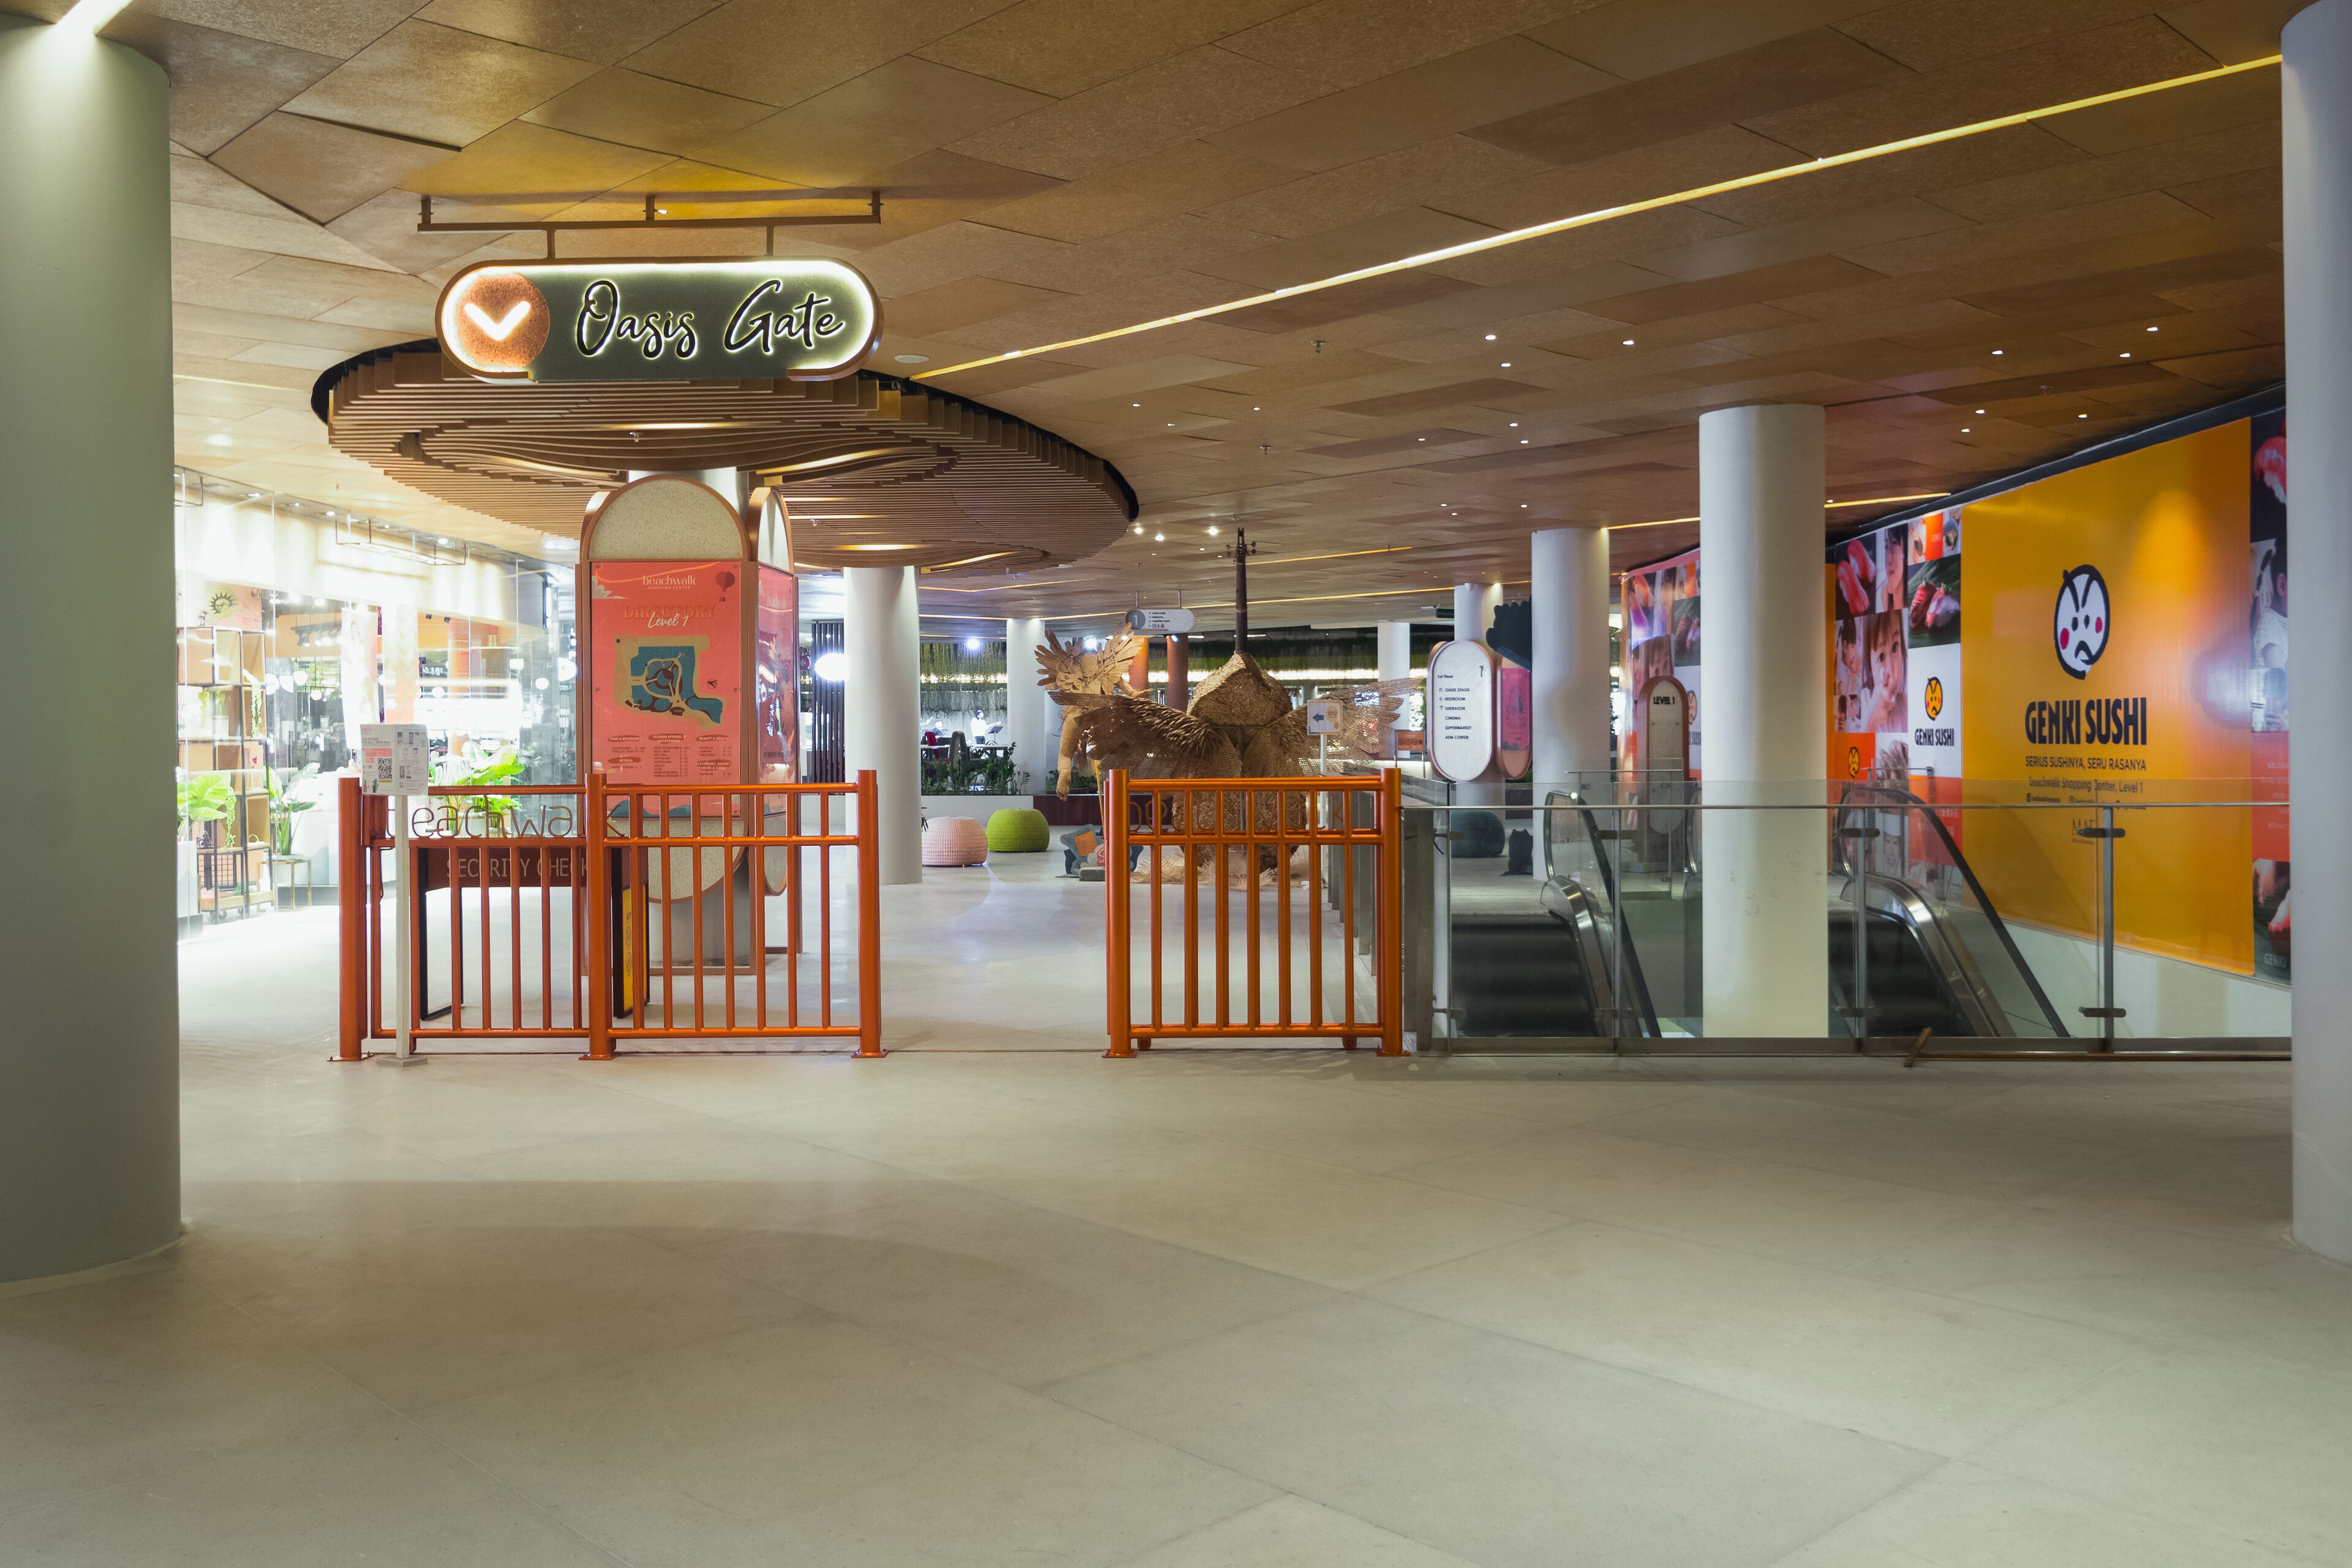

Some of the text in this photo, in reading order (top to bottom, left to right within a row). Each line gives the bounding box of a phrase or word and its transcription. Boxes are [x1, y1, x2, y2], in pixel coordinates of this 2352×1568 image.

[576, 279, 845, 358] Oasis Gate
[643, 575, 696, 586] beachwalk
[647, 611, 689, 628] Level 1
[1133, 614, 1138, 625] 1
[1653, 696, 1675, 705] LEVEL 1
[2024, 697, 2147, 745] GENKI SUSHI
[1914, 728, 1954, 747] GENKI SUSHI
[2026, 756, 2147, 772] SERIUS SUSHINYA, SERU RASANYA
[2119, 782, 2138, 793] Level
[447, 858, 530, 878] ECRIY
